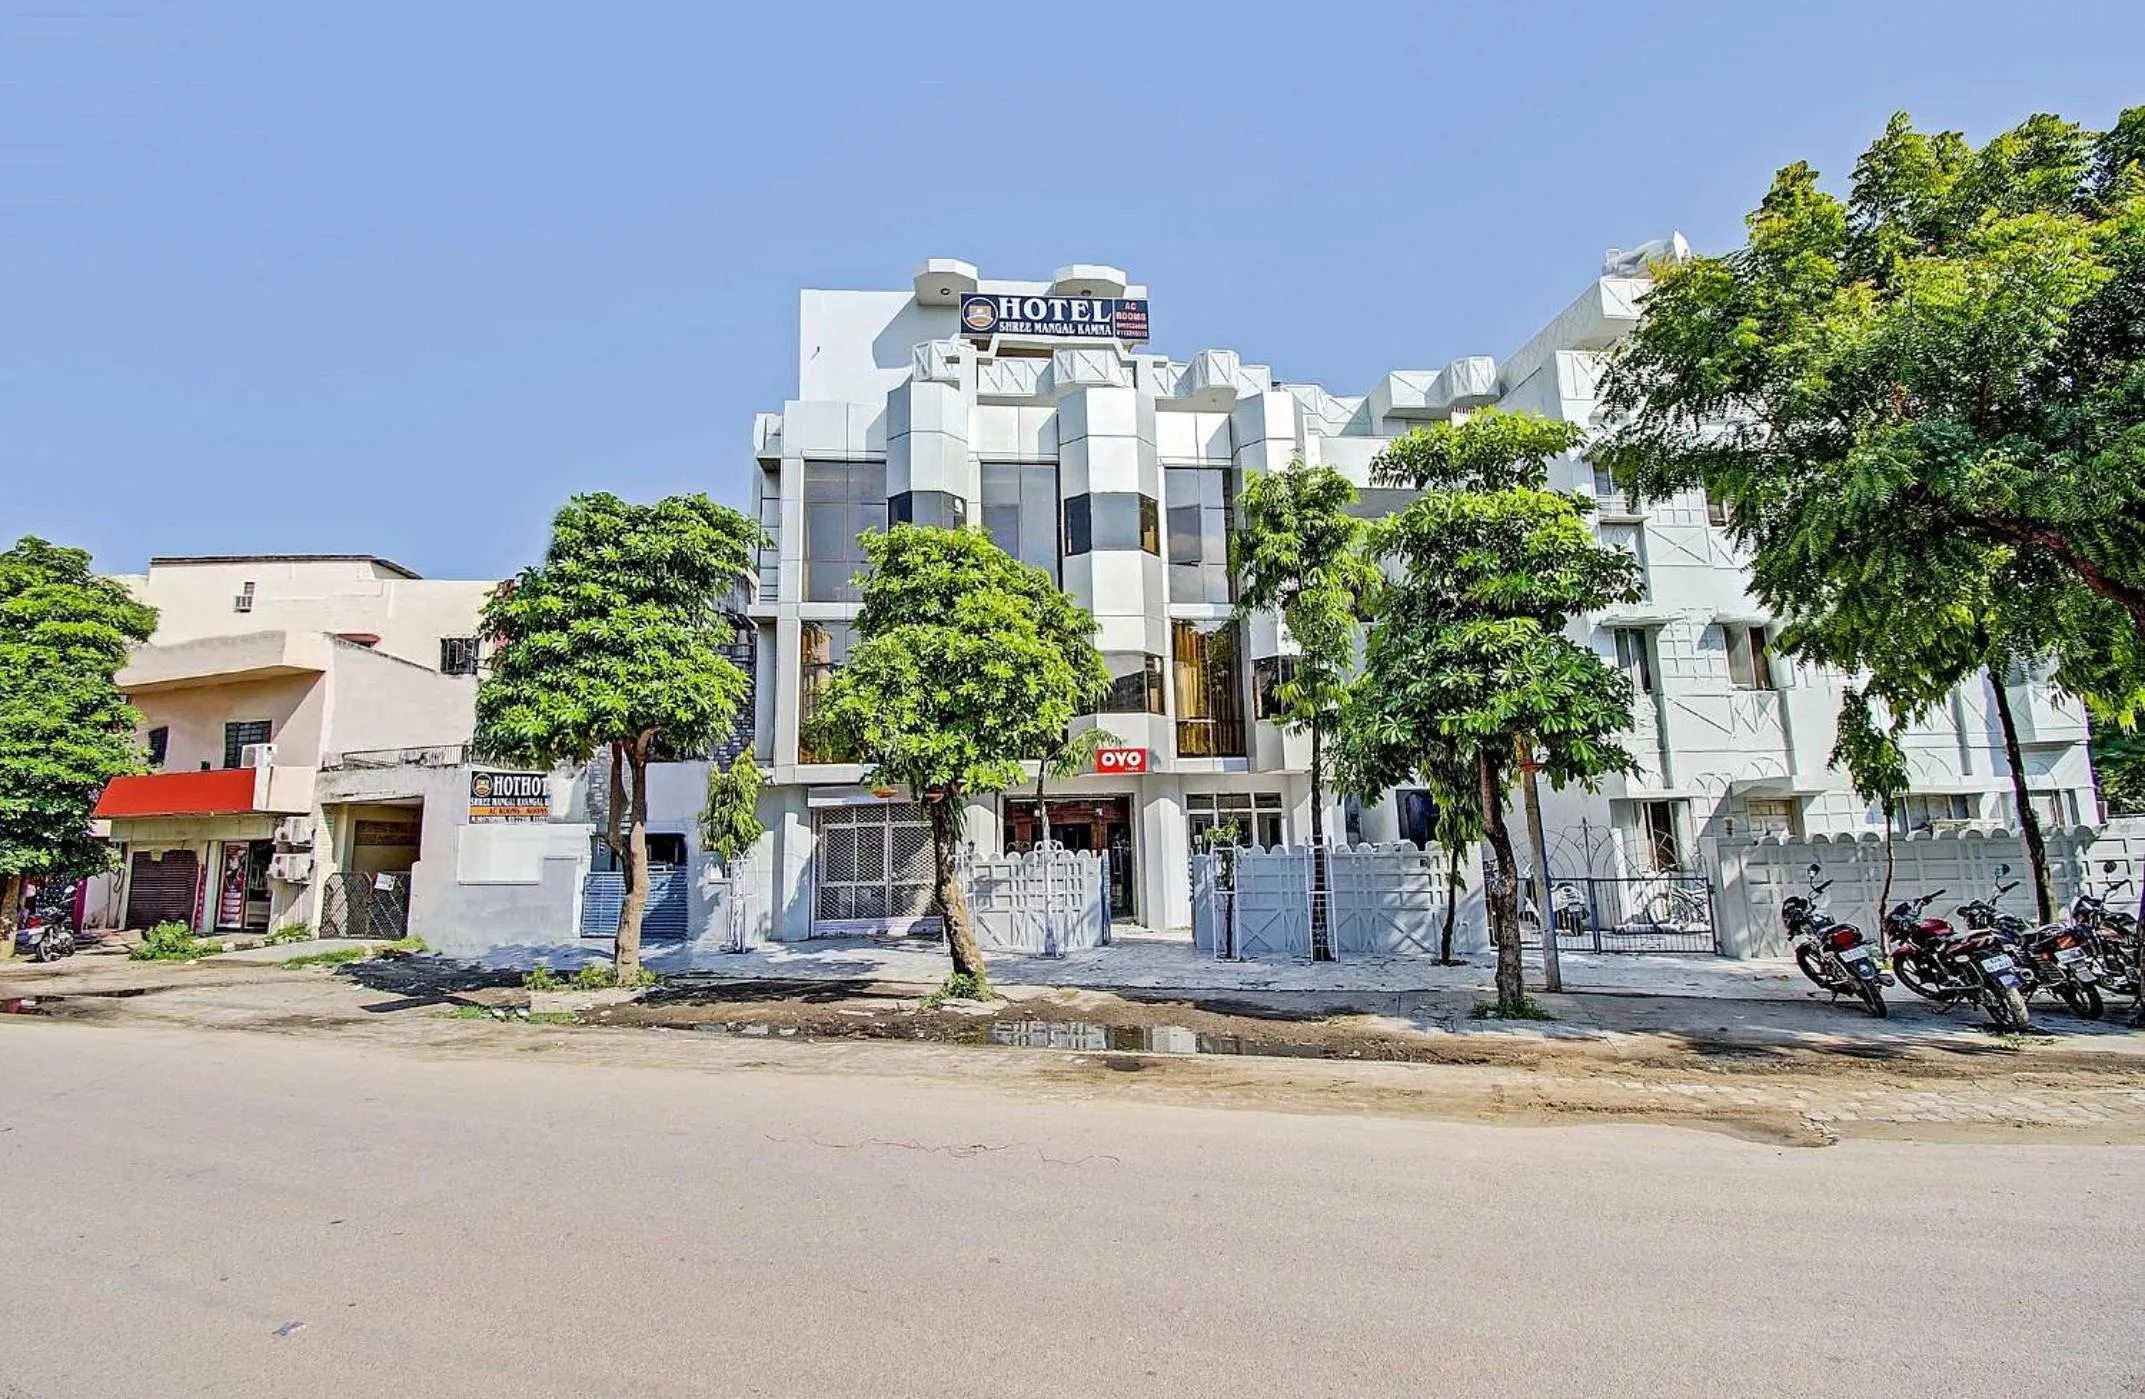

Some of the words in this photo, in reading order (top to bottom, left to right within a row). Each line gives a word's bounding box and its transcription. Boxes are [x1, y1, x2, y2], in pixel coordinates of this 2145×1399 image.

[999, 297, 1111, 322] HOTEL
[1124, 301, 1137, 310] AC
[1116, 311, 1147, 321] ROOMS
[999, 322, 1032, 333] SHREE
[1035, 322, 1075, 335] MANGAL
[1077, 323, 1112, 336] KAMNA
[1101, 751, 1142, 767] OYO
